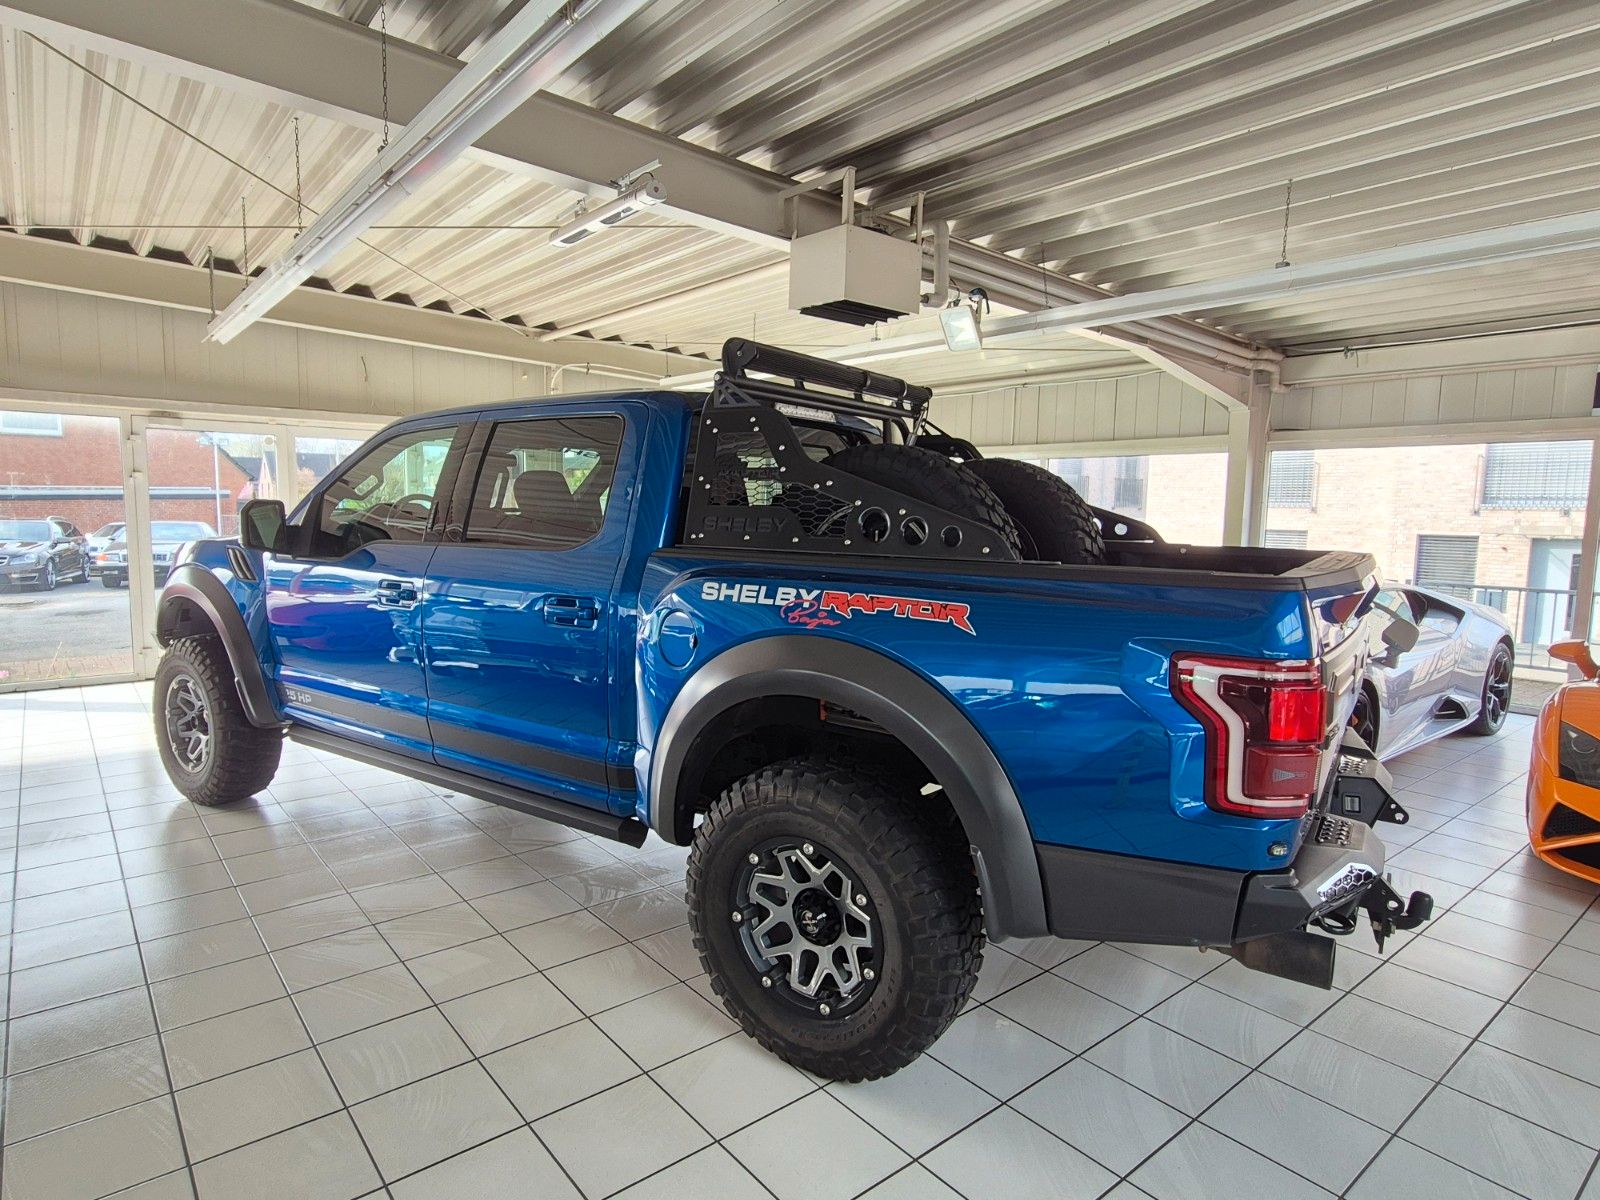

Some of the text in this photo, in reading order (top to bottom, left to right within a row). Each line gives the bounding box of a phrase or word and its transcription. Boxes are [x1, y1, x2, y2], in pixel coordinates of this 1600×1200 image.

[703, 516, 787, 533] SHELBY
[701, 582, 976, 636] SHELBY RAPTOR
[297, 691, 312, 703] HP
